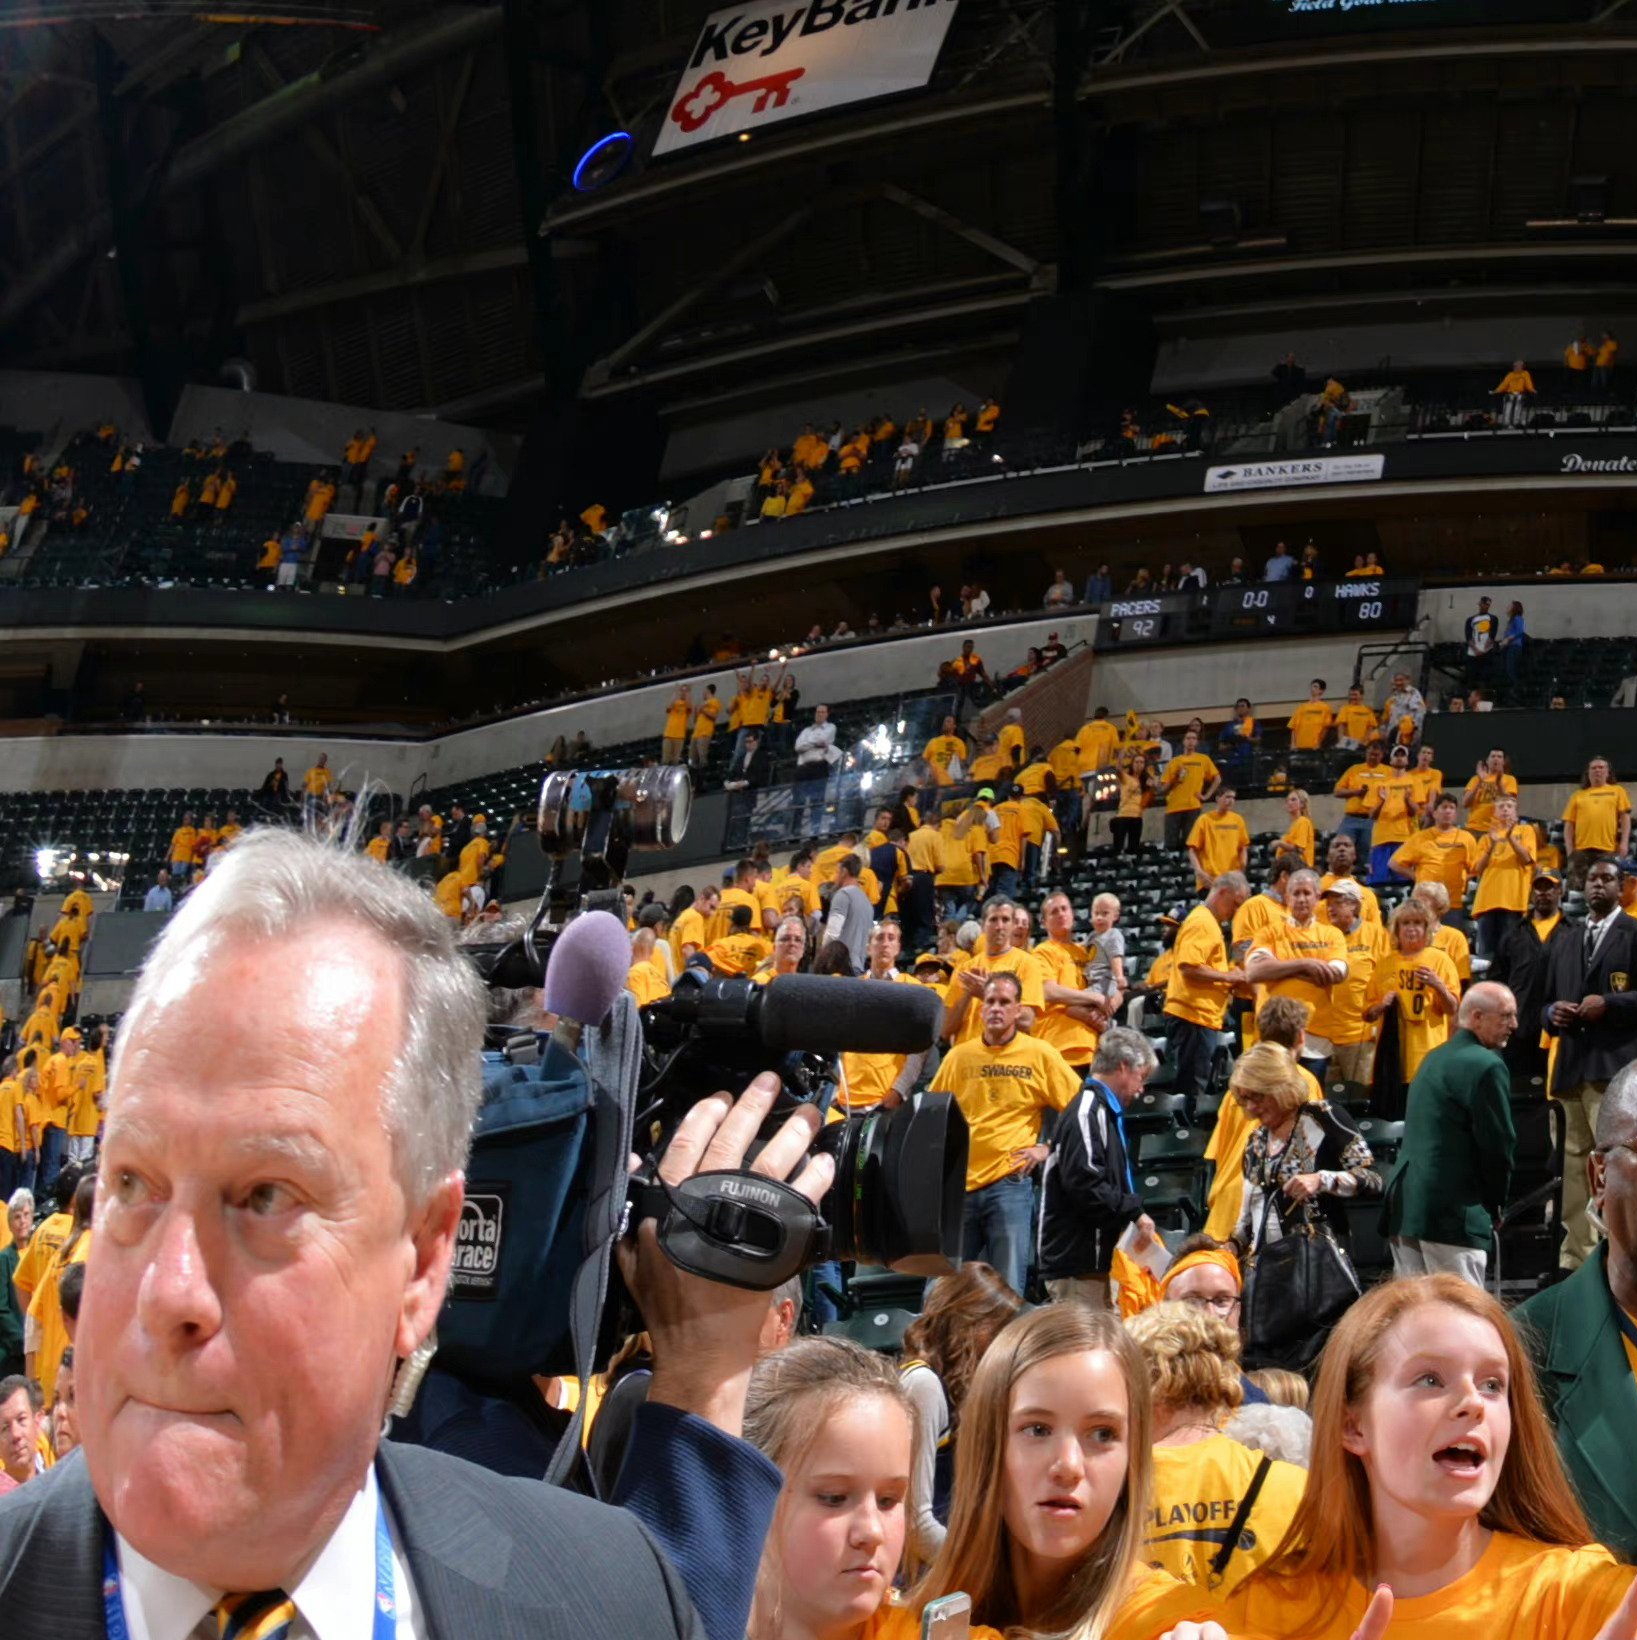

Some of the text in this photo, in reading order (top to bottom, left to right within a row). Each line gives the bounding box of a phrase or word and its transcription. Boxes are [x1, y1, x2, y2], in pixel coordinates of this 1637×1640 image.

[690, 0, 957, 68] KeyBan
[1242, 461, 1323, 478] BANKERS
[1335, 582, 1380, 599] HAWKS
[1111, 600, 1161, 618] PACERS
[1358, 601, 1382, 619] 80
[1132, 620, 1154, 637] 92
[719, 1178, 782, 1208] FUJINON
[456, 1216, 498, 1238] orta
